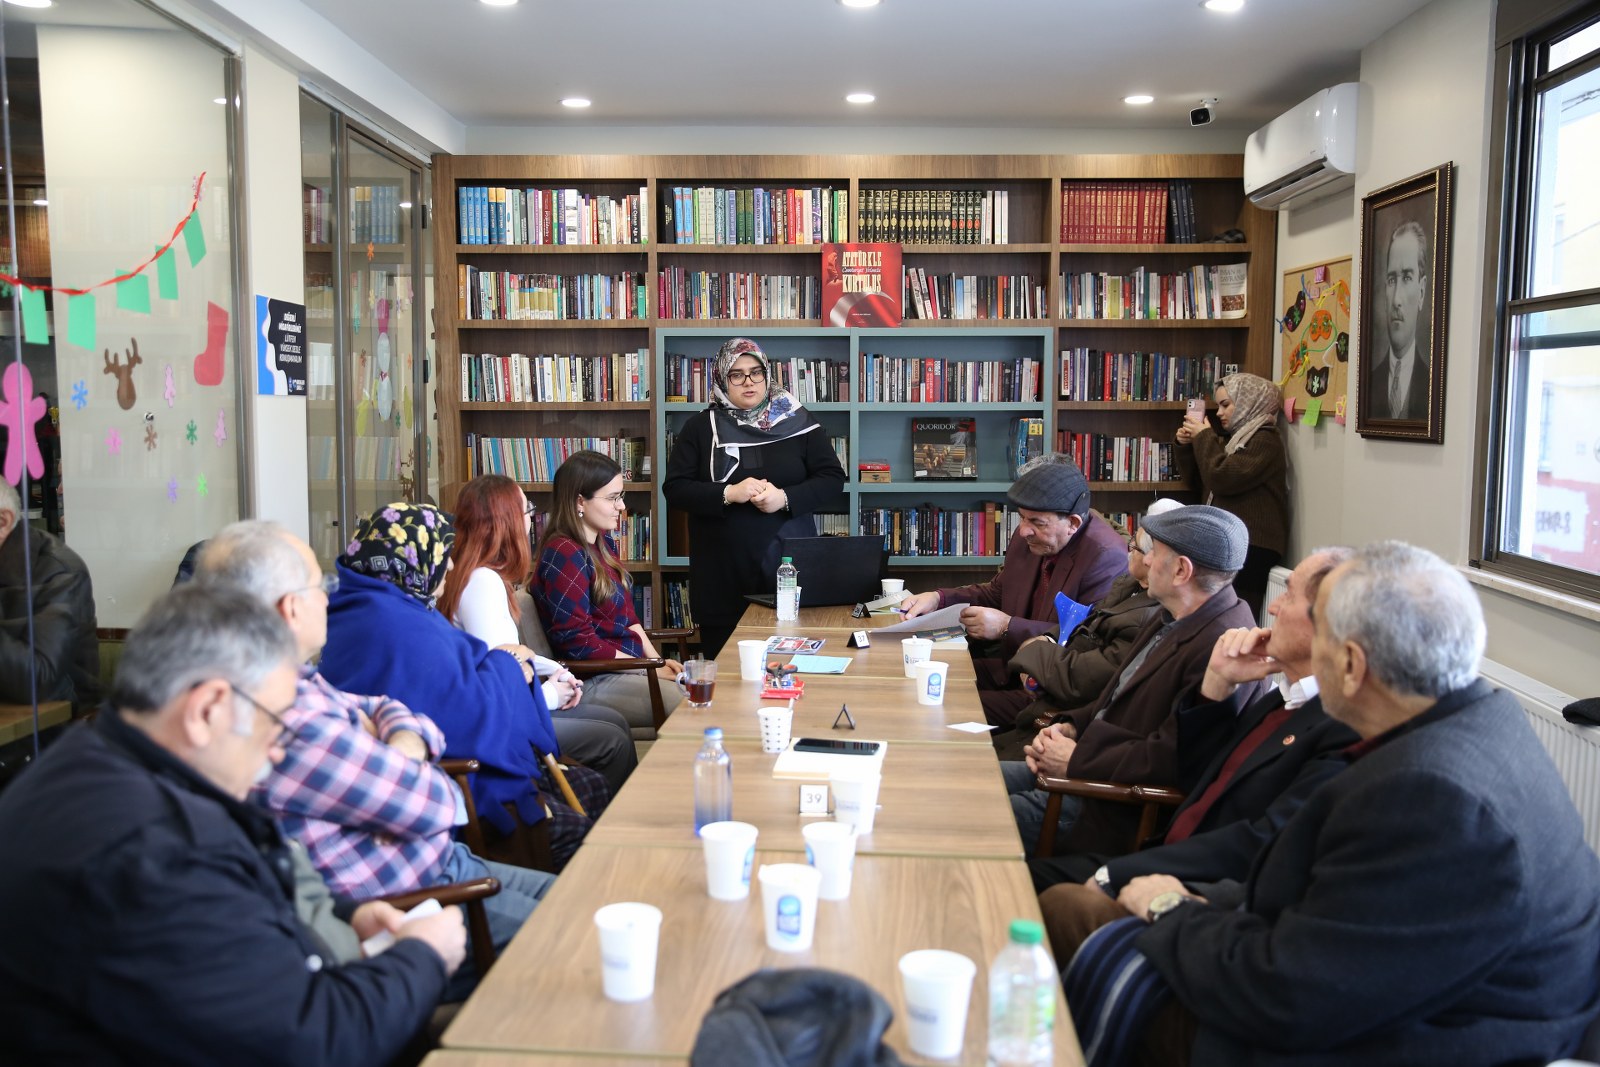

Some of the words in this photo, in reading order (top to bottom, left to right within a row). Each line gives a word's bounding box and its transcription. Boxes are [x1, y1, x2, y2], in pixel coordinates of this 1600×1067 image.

[842, 250, 882, 267] ATATÜRKLE
[285, 333, 297, 343] LÜTFEN
[280, 342, 292, 352] YÜKSEK
[291, 345, 301, 354] SESLE
[916, 423, 956, 431] QUORIDOR
[857, 635, 865, 643] 37
[806, 793, 822, 804] 39
